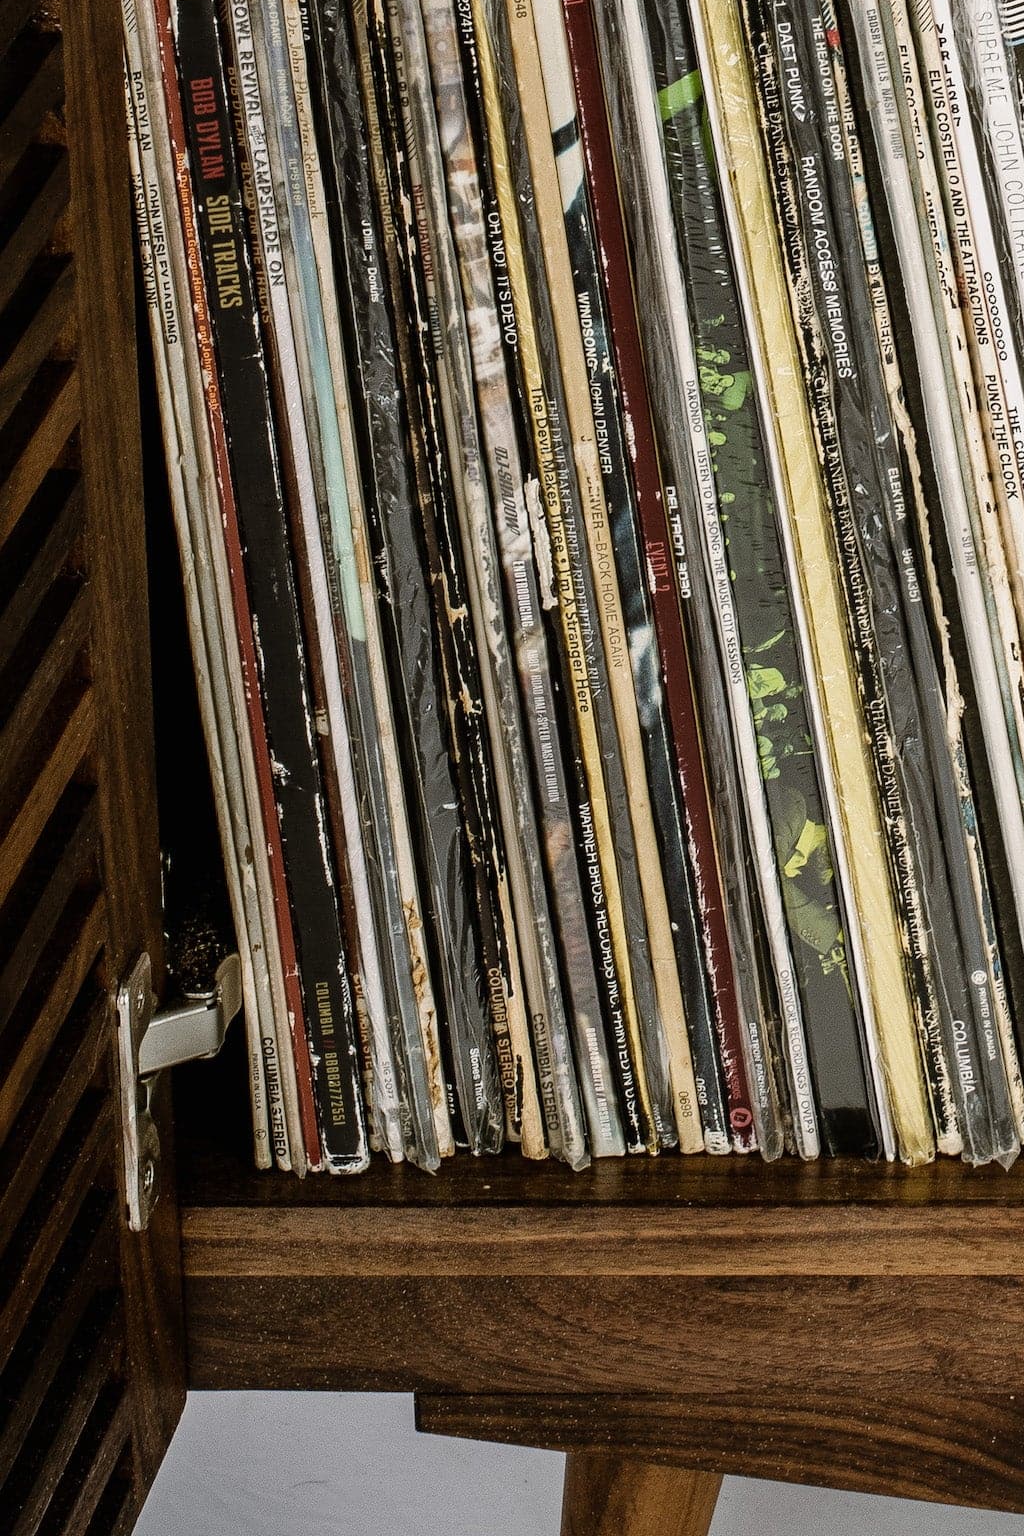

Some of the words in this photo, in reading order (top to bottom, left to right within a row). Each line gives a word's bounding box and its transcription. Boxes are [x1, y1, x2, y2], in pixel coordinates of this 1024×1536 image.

[776, 22, 797, 63] DAFT
[809, 15, 825, 40] THE
[814, 42, 832, 75] HEAD
[189, 76, 218, 115] BOB
[239, 51, 262, 121] REVIVAL
[785, 67, 805, 109] PUNK
[821, 78, 834, 97] ON
[928, 69, 947, 108] ELVIS
[975, 11, 1006, 104] SUPREME
[994, 120, 1020, 172] JOHN
[288, 43, 304, 74] John
[302, 151, 322, 219] Rebennack
[824, 99, 839, 123] THE
[195, 120, 226, 179] DYLAN
[827, 125, 845, 160] DOOR
[936, 111, 961, 185] COSTELLO
[204, 195, 233, 234] SIDE
[800, 156, 825, 225] RANDOM
[949, 188, 966, 217] AND
[252, 149, 280, 254] LAMPSHADE
[267, 260, 284, 286] ON
[956, 221, 972, 248] THE
[210, 240, 242, 307] TRACKS
[812, 228, 837, 290] ACCESS
[192, 277, 207, 320] Harrison
[870, 286, 893, 355] NUMBERS
[961, 250, 989, 345] ATTRACTIONS
[499, 302, 517, 344] DEVO
[825, 295, 853, 378] MEMORIES
[530, 386, 545, 412] The
[985, 374, 1006, 420] PUNCH
[1006, 406, 1021, 435] THE
[534, 418, 551, 455] Devil
[593, 419, 614, 474] DENVER
[995, 424, 1010, 451] THE
[540, 459, 559, 507] Makes
[887, 467, 906, 521] ELEKTRA
[999, 454, 1019, 499] CLOCK
[549, 513, 566, 552] Three
[664, 486, 685, 556] DELTRON
[675, 561, 690, 598] 3030
[684, 380, 703, 434] DARONDO
[696, 449, 711, 480] LISTEN
[707, 522, 722, 555] SONG:
[716, 578, 730, 607] MUSIC
[724, 636, 742, 684] SESSIONS
[600, 582, 618, 623] HOME
[904, 567, 920, 602] 04351
[563, 611, 587, 673] Stranger
[606, 626, 625, 667] AGAIN
[573, 678, 592, 713] Here
[880, 763, 904, 824] DANIELS
[578, 801, 598, 863] WARNER
[594, 910, 616, 979] RECORDS
[611, 1011, 631, 1070] PRINTED
[314, 981, 334, 1035] COLUMBIA
[779, 969, 798, 1023] OMNIVORE
[469, 1047, 483, 1080] Stones
[497, 1038, 515, 1087] STEREO
[532, 1012, 552, 1078] COLUMBIA
[787, 1025, 808, 1089] RECORDINGS
[951, 1020, 976, 1093] COLUMBIA
[260, 1036, 280, 1105] COLUMBIA
[541, 1080, 559, 1130] STEREO
[677, 1091, 692, 1118] 0698
[799, 1100, 815, 1134] OVLP-9
[269, 1107, 286, 1157] STEREO
